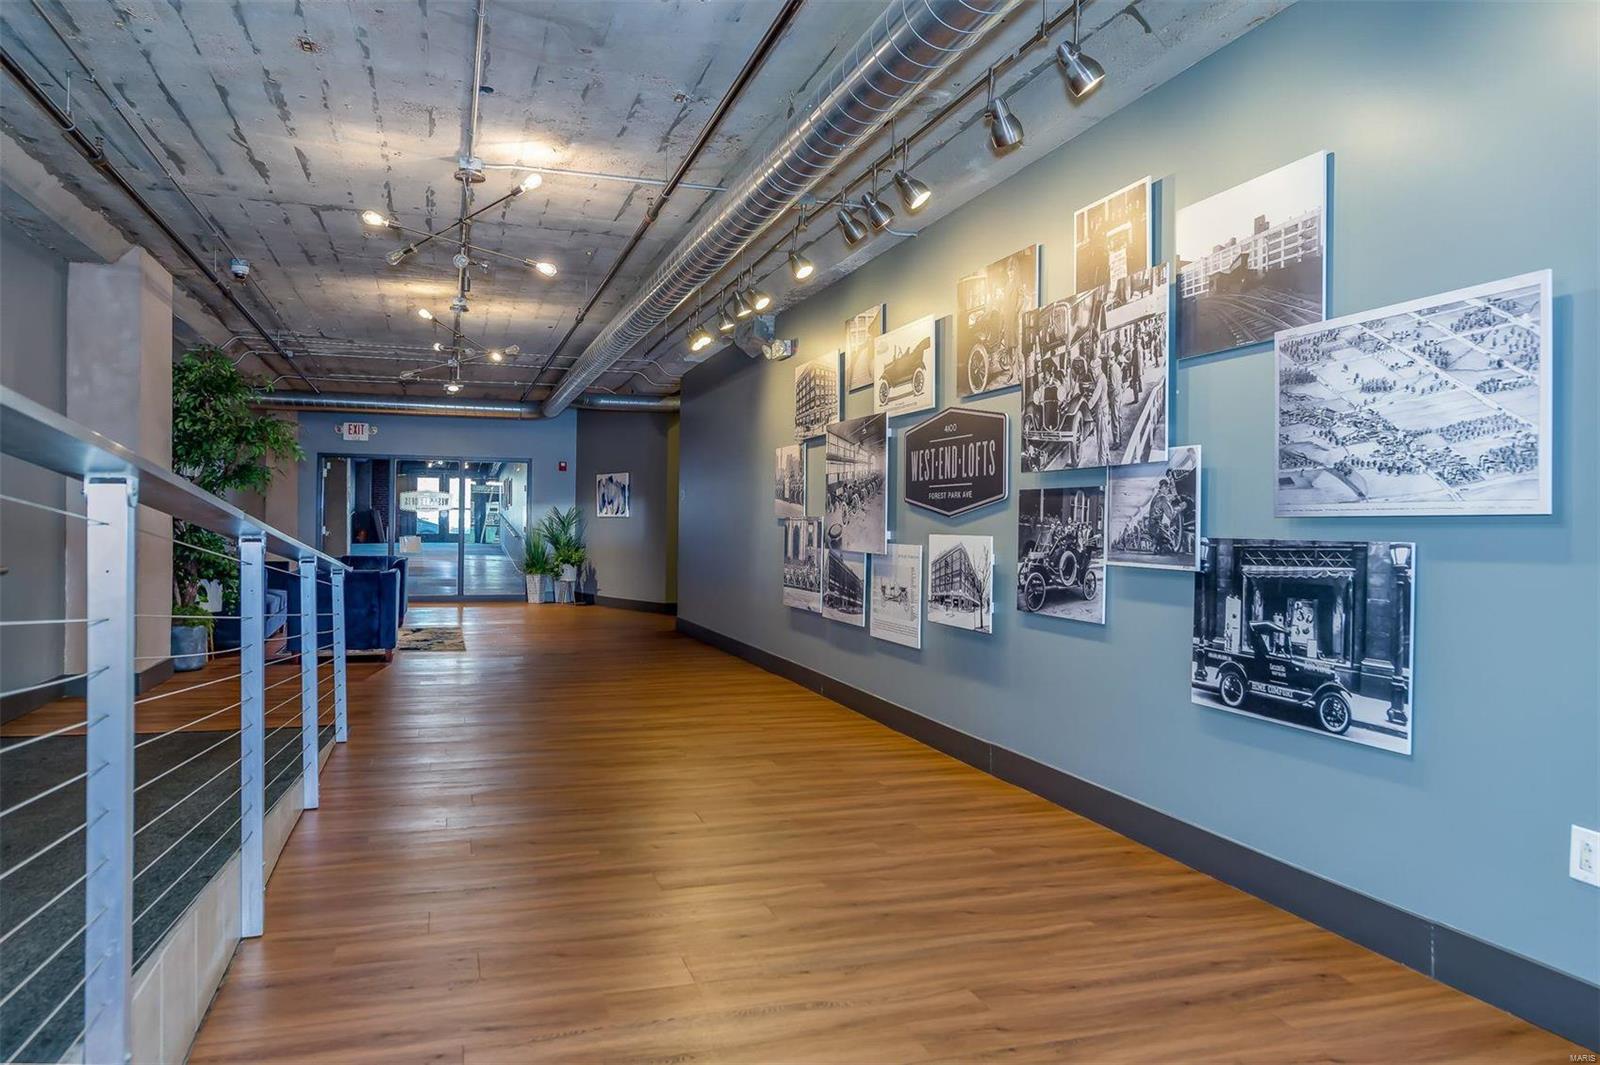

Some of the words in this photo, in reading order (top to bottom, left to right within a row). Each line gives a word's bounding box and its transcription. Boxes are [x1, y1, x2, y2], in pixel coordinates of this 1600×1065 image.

[348, 423, 365, 435] EXIT
[929, 491, 946, 500] FOREST
[948, 491, 961, 499] PARK
[962, 490, 973, 498] AVE
